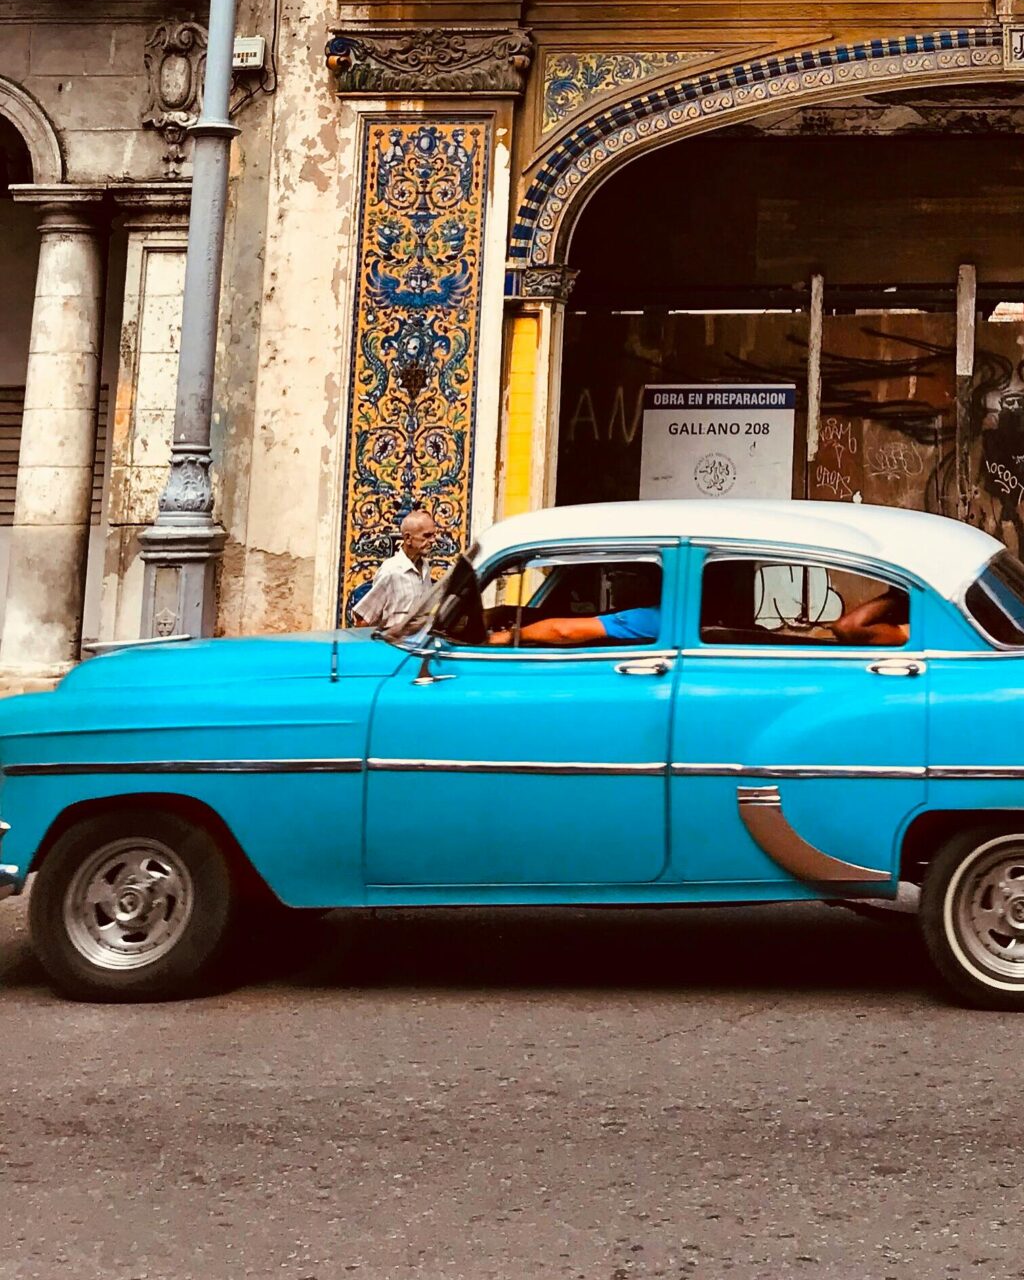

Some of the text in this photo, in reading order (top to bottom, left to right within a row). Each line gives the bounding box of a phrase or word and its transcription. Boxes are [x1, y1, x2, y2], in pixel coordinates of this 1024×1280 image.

[654, 392, 786, 405] OBRA EN PREPARACION
[744, 423, 770, 435] 208
